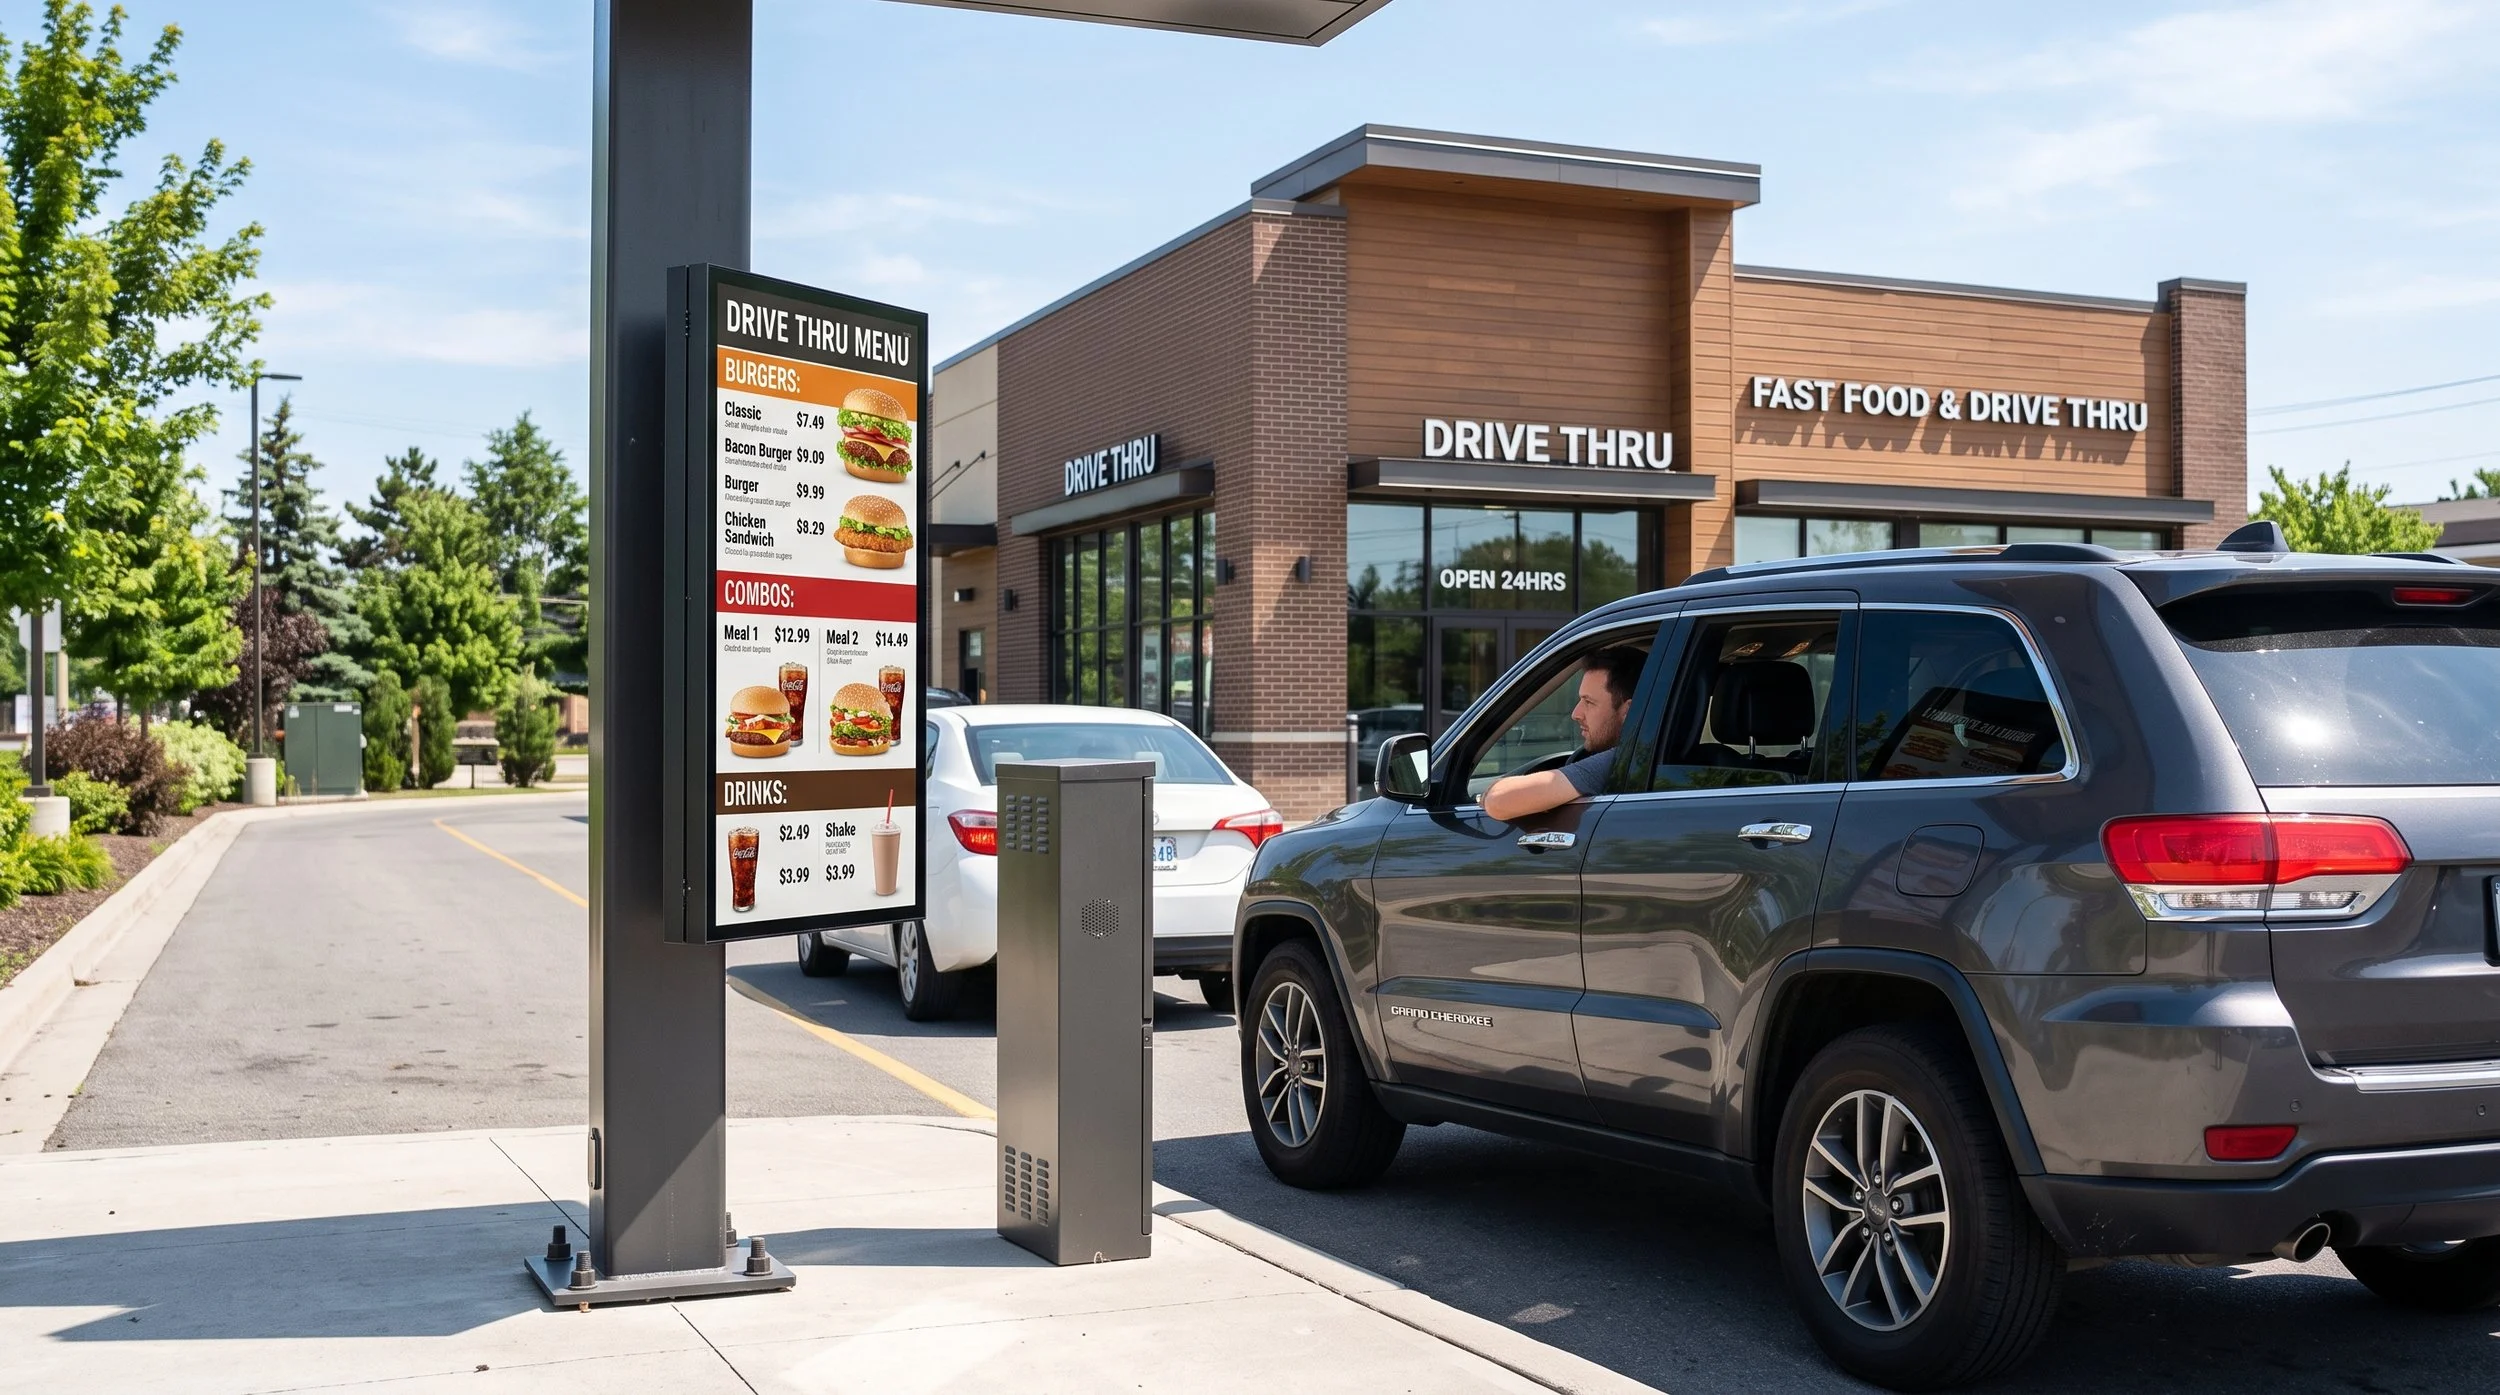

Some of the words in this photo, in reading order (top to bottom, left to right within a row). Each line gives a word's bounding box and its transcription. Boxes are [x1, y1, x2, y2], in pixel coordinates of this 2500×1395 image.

[726, 299, 789, 343] DRIVE
[795, 314, 848, 355] THRU
[855, 325, 910, 366] MENU
[725, 357, 800, 393] BURGERS:
[725, 401, 762, 421] Classic
[796, 411, 824, 430] $7.49
[1751, 376, 1836, 411] FAST
[1843, 382, 1930, 418] FOOD
[1939, 388, 1961, 420] &
[1969, 390, 2060, 426] DRIVE
[2066, 397, 2148, 433] THRU
[725, 437, 756, 456] Bacon
[759, 443, 792, 463] Burger
[796, 447, 825, 465] $9.09
[1423, 418, 1550, 462] DRIVE
[1559, 425, 1673, 469] THRU
[1064, 449, 1108, 497] DRIVE
[1110, 433, 1156, 483] THRU
[725, 475, 759, 495] Burger
[796, 482, 824, 500] $9.99
[725, 511, 766, 529] Chicken
[796, 519, 825, 537] $8.29
[725, 529, 774, 547] Sandwich
[1439, 568, 1496, 590] OPEN
[1501, 570, 1567, 592] 24HRS
[724, 579, 794, 608] COMBOS:
[724, 624, 750, 641] Meal
[752, 626, 758, 641] 1
[774, 625, 810, 644] $12.99
[826, 629, 850, 645] Meal
[852, 630, 859, 645] 2
[875, 629, 909, 648] $14.49
[724, 779, 788, 807] DRINKS:
[779, 823, 810, 843] $2.49
[825, 821, 856, 838] Shake
[779, 867, 810, 886] $3.99
[825, 863, 855, 882] $3.99
